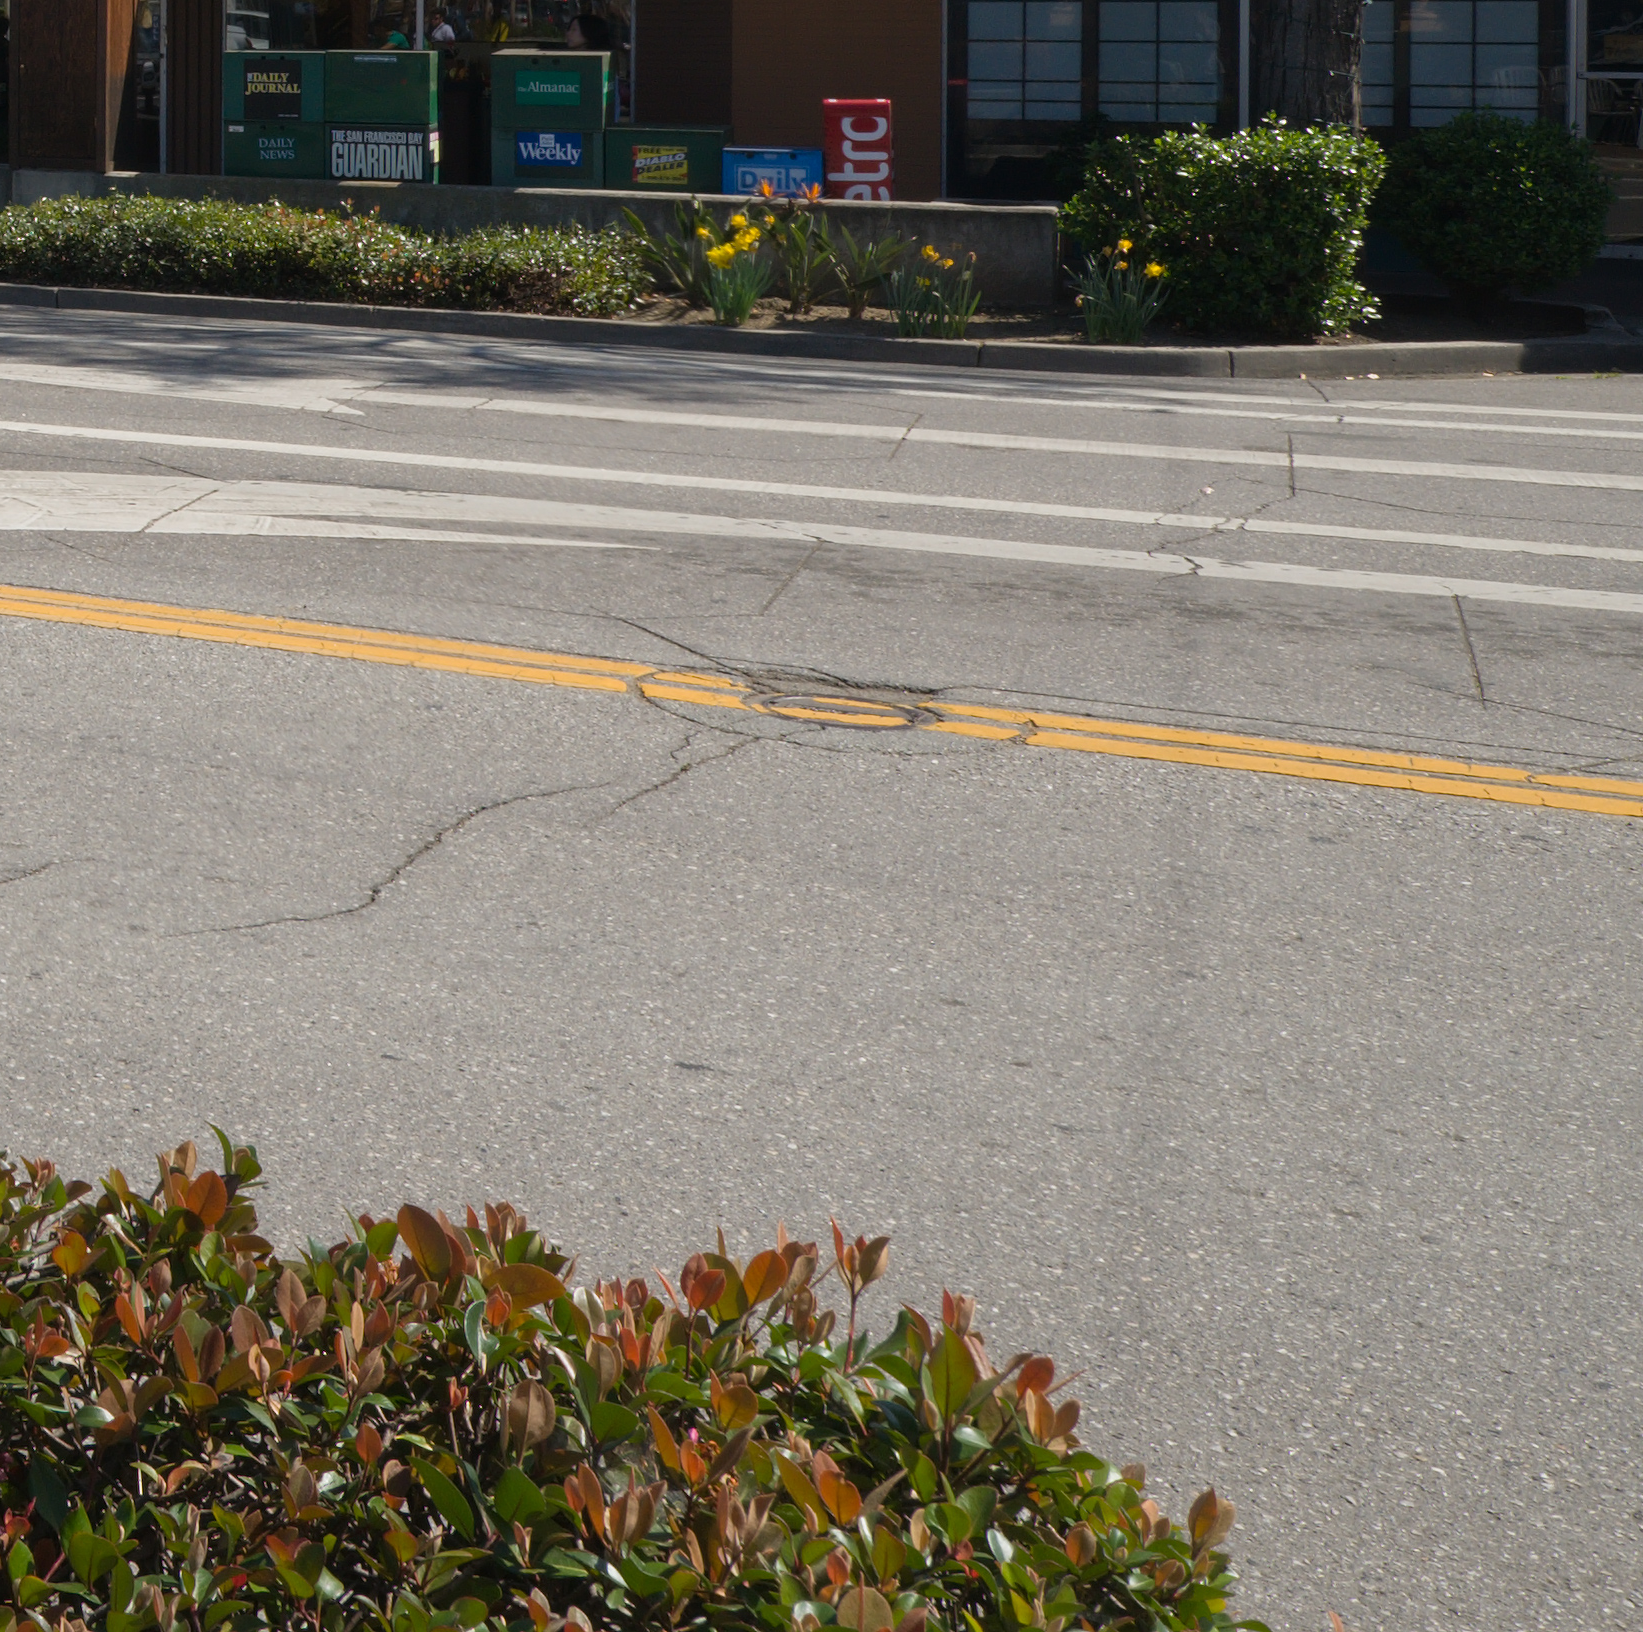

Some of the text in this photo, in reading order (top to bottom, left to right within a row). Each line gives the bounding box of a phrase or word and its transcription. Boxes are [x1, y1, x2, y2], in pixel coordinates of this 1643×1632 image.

[253, 72, 290, 83] DAILY
[245, 83, 301, 95] JOURNAL
[527, 81, 579, 94] Almanac
[259, 138, 295, 148] DAILY
[331, 129, 347, 142] THE
[347, 130, 365, 142] SAN
[365, 131, 406, 144] FRANCISCO
[260, 149, 295, 159] NEWS
[518, 142, 582, 165] Weekly
[331, 143, 423, 180] GUARDIAN
[635, 153, 686, 168] DIABLO
[637, 161, 685, 175] DEALER
